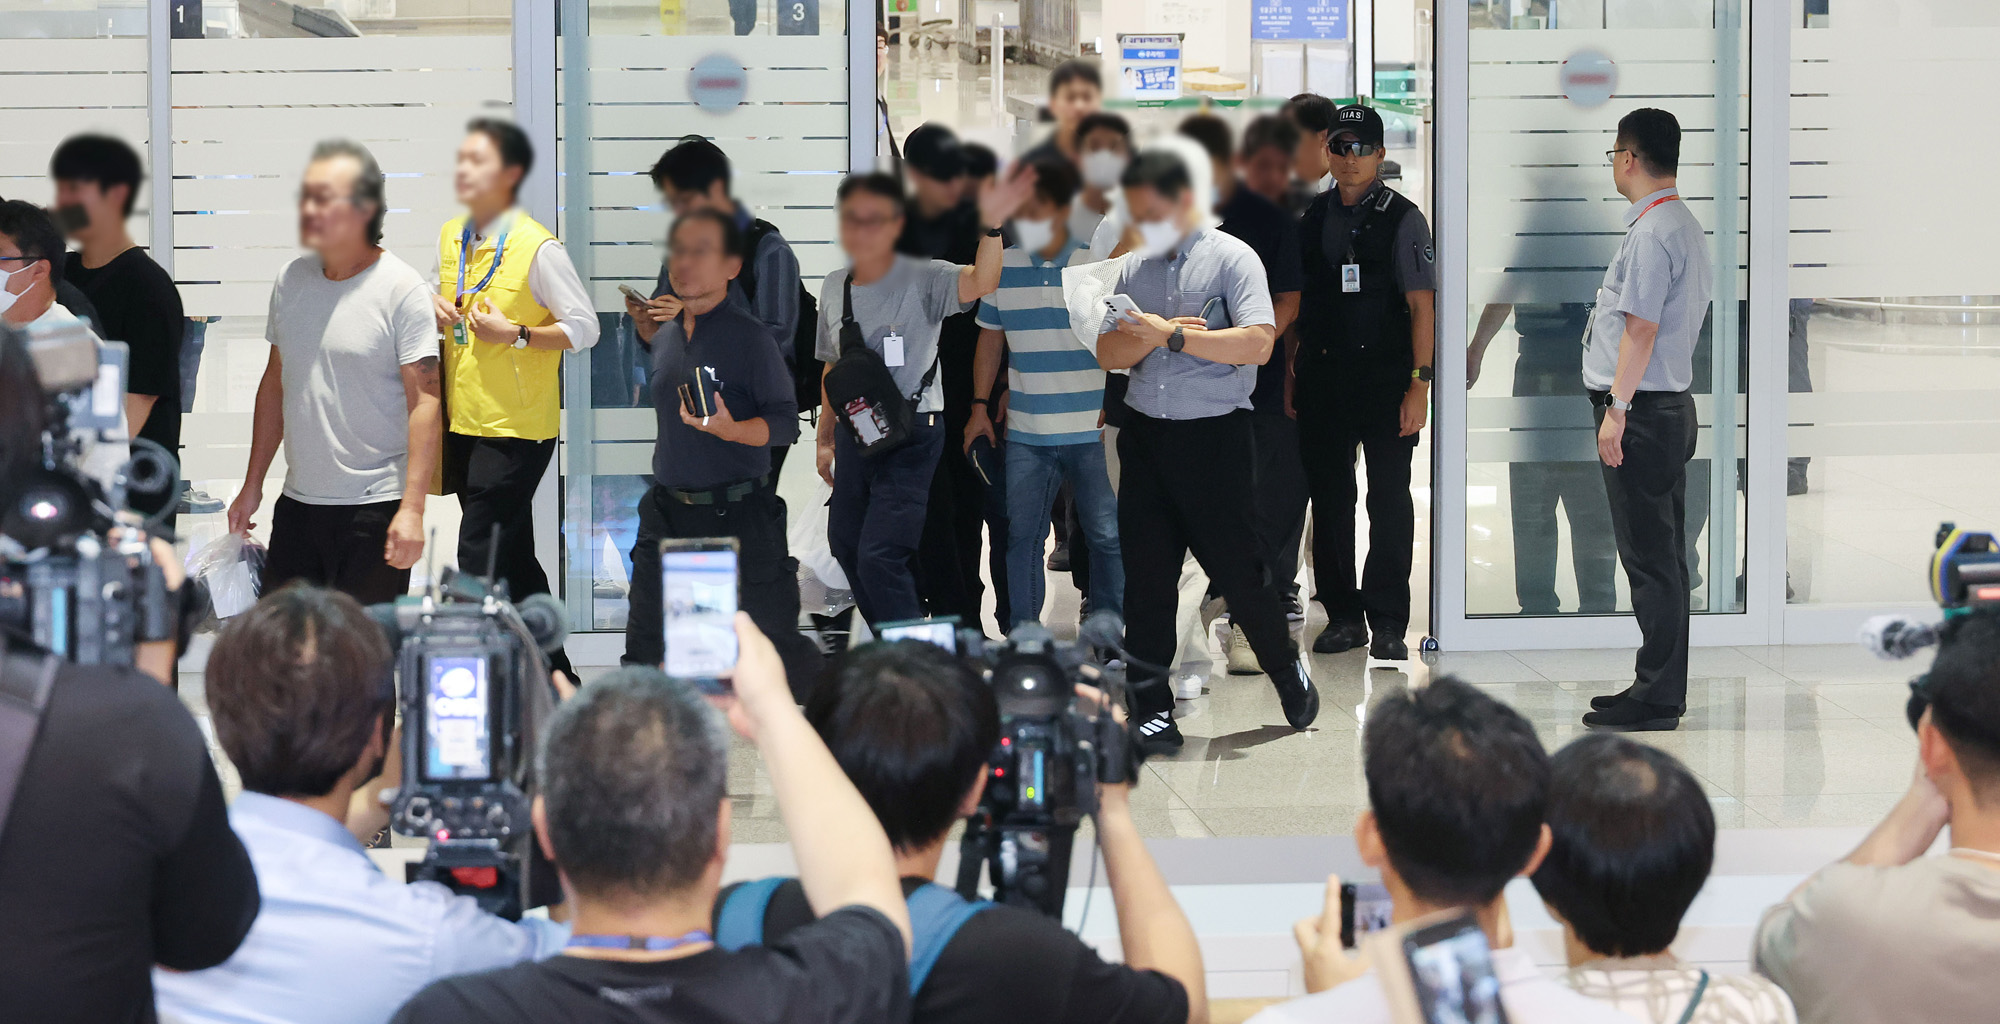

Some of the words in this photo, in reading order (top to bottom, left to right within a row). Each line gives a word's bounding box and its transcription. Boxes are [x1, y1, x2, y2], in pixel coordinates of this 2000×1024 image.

[176, 5, 184, 23] 1
[792, 2, 805, 21] 3
[1342, 110, 1362, 119] IIAS
